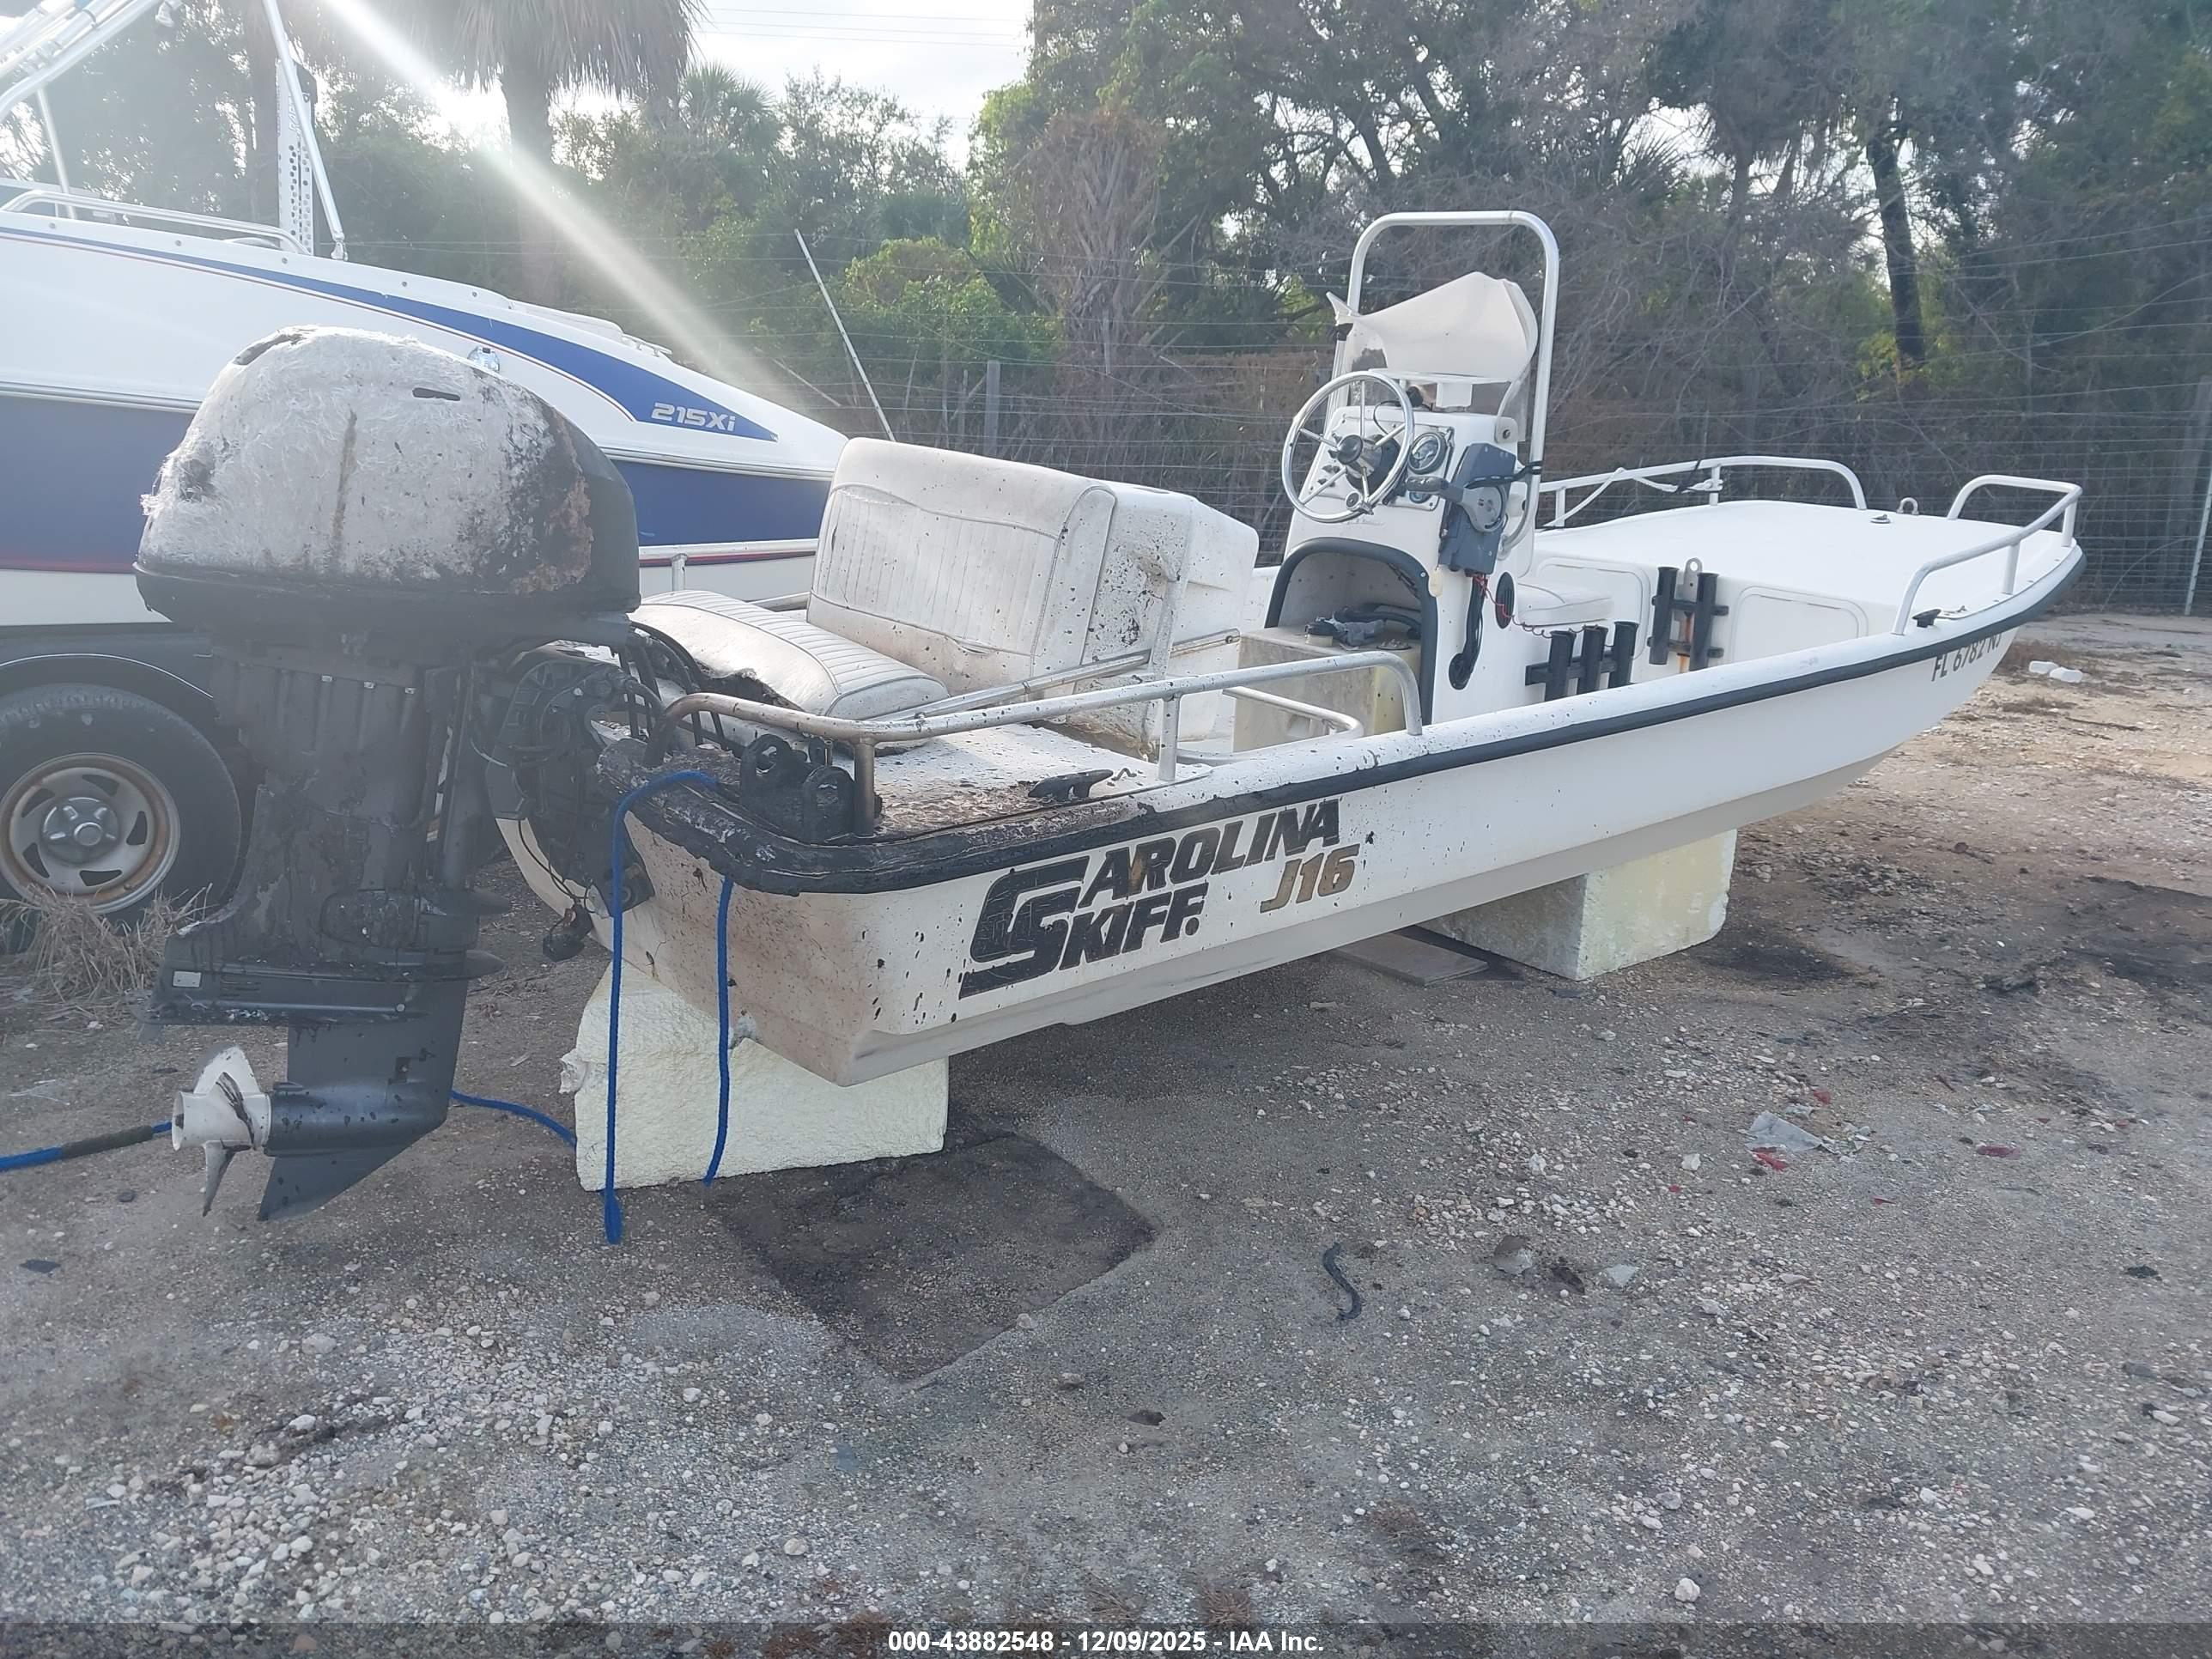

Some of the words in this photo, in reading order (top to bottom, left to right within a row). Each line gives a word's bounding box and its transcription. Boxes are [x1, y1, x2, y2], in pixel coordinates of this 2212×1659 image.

[651, 403, 736, 432] 215Xi
[1931, 653, 1948, 682] FL
[969, 799, 1340, 963] CAROLINA
[1260, 844, 1360, 914] J16
